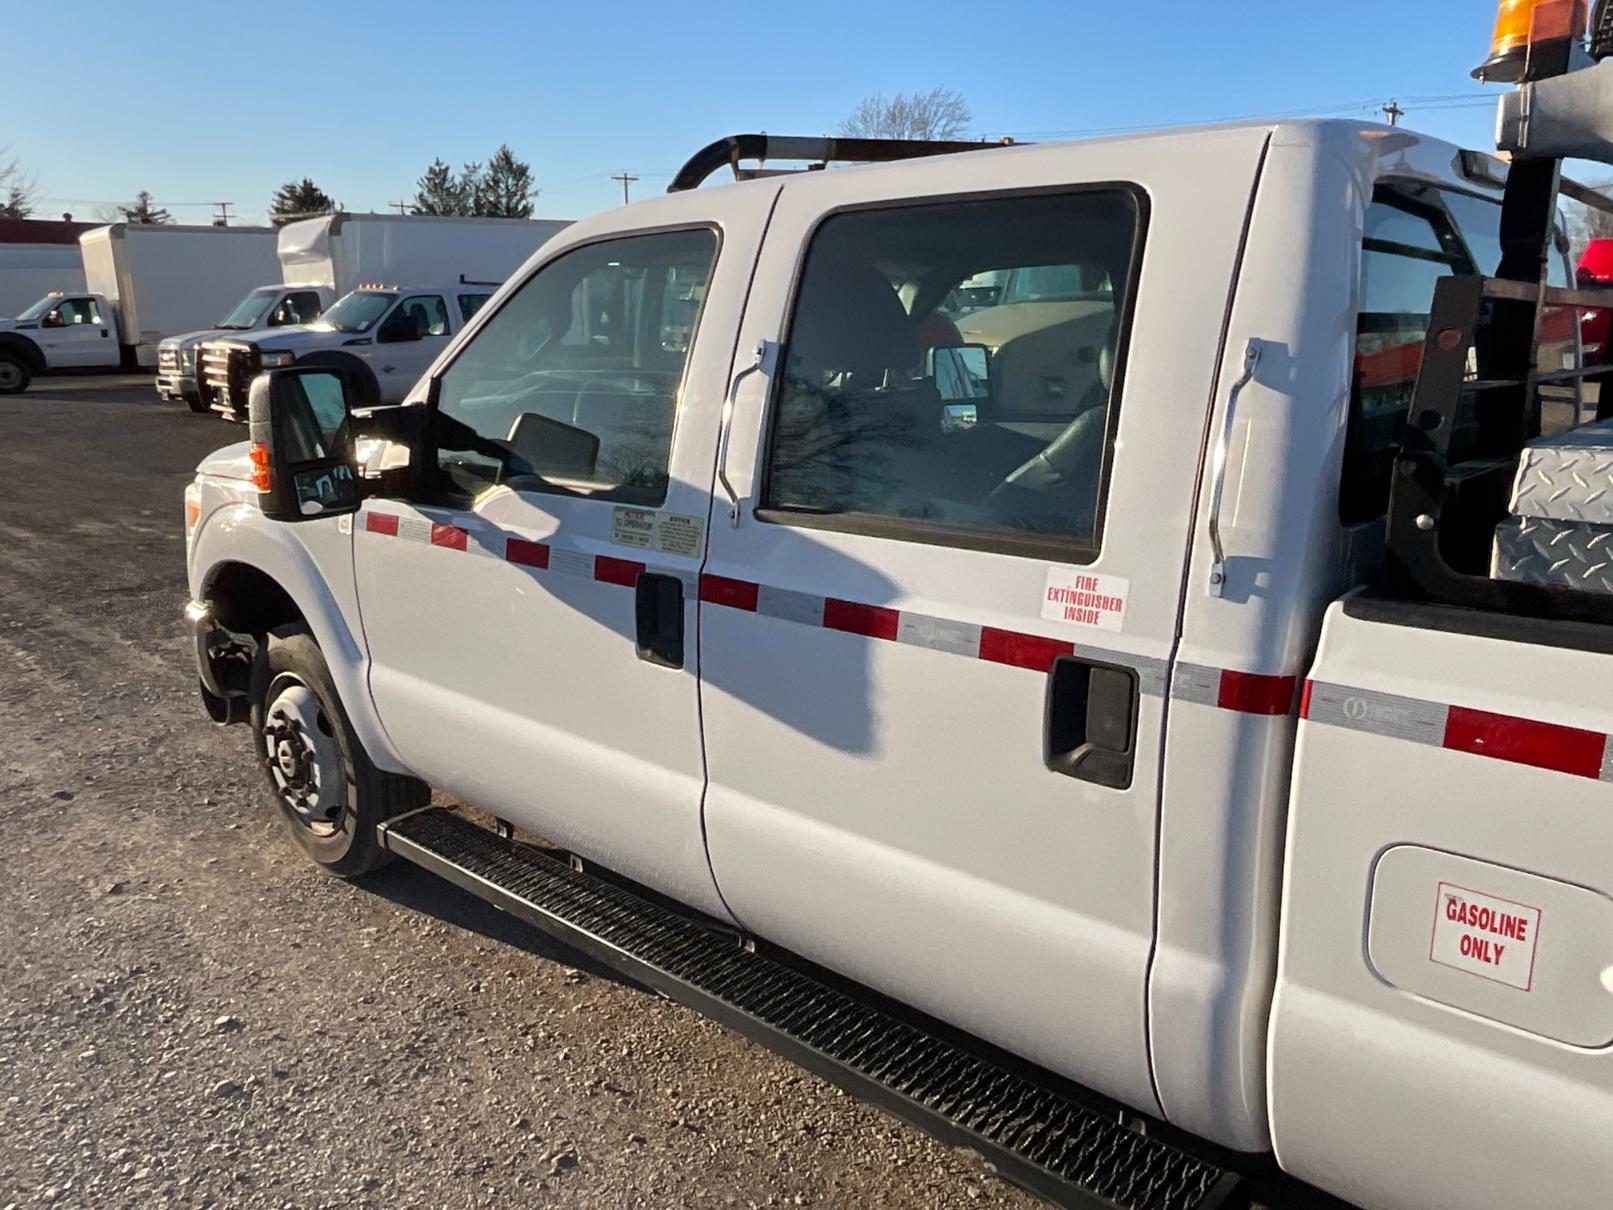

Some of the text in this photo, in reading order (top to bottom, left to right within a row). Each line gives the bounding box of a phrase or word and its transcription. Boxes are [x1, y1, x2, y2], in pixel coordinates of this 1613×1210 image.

[1075, 575, 1099, 592] FIRE
[1047, 587, 1123, 612] EXTINGUISHER
[1064, 606, 1101, 625] INSIDE
[1446, 897, 1528, 942] GASOLINE
[1459, 934, 1505, 966] ONLY
